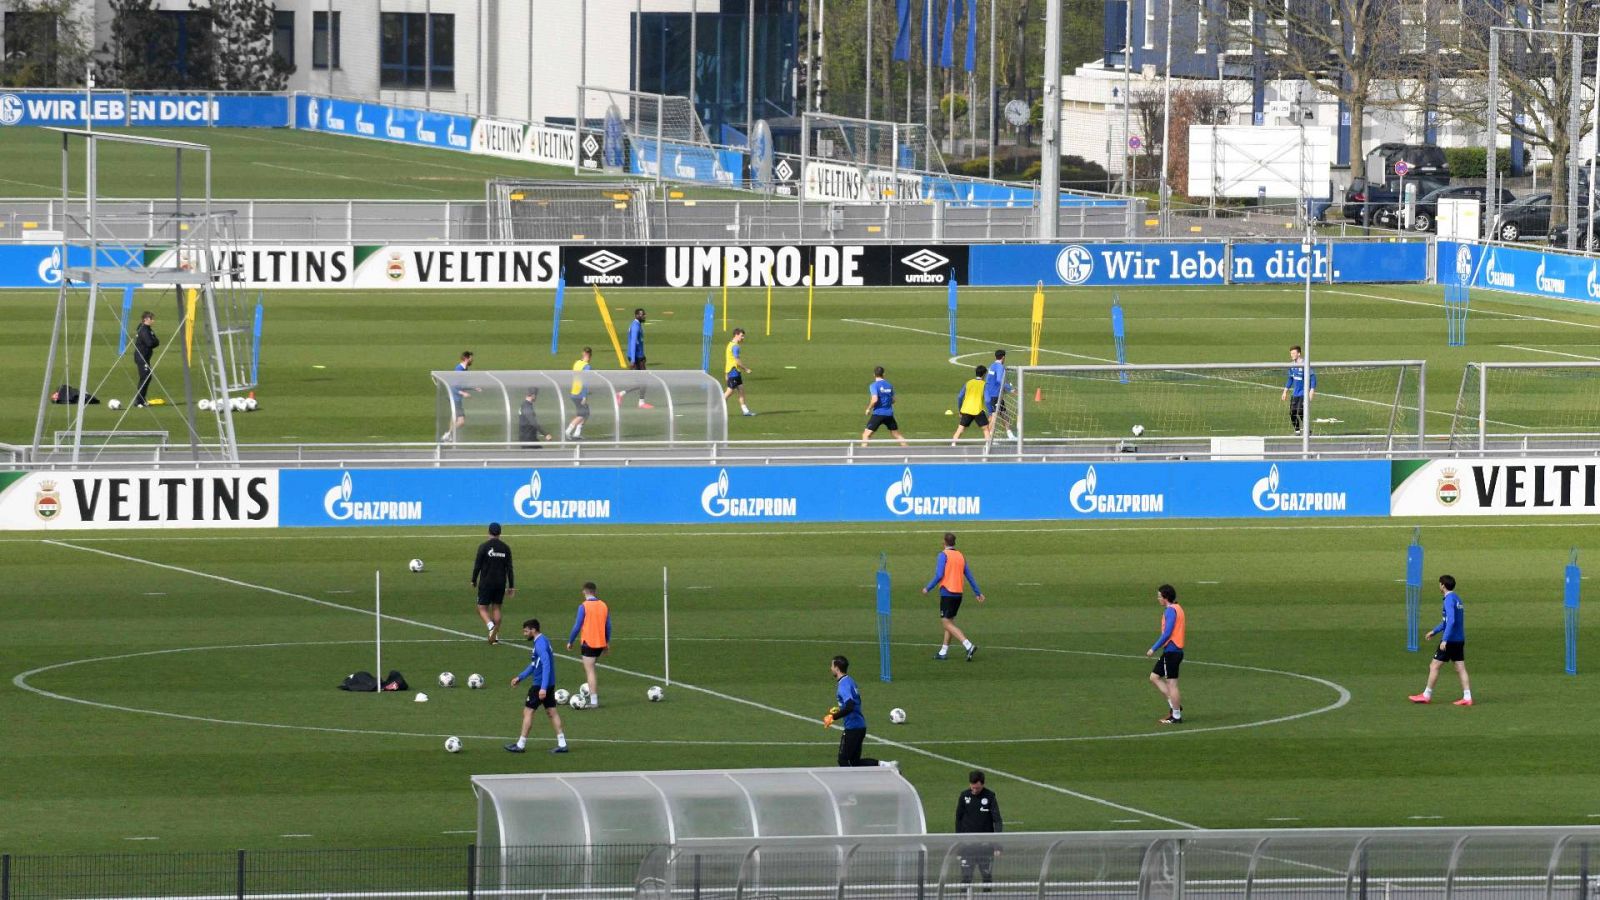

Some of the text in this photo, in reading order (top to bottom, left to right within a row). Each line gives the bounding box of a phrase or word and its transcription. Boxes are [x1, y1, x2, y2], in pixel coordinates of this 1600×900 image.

[28, 100, 76, 120] WIR
[80, 100, 156, 120] LEBEN
[160, 100, 220, 121] DICH
[485, 124, 521, 153] VELTINS
[537, 131, 574, 161] VELTINS
[817, 167, 859, 200] VELTINS
[413, 250, 553, 283] VELTINS
[665, 246, 865, 287] UMBRO.DE
[1101, 250, 1340, 279] Wir leben dich.
[583, 273, 624, 284] umbro
[905, 273, 944, 284] umbro
[1472, 465, 1596, 507] VELTI
[72, 477, 270, 521] VELTINS
[543, 499, 610, 518] GAZPROM
[730, 497, 797, 516] GAZPROM
[914, 496, 980, 515] GAZPROM
[1097, 494, 1164, 512] GAZPROM
[1280, 492, 1346, 511] GAZPROM
[354, 500, 422, 520] GAZPROM
